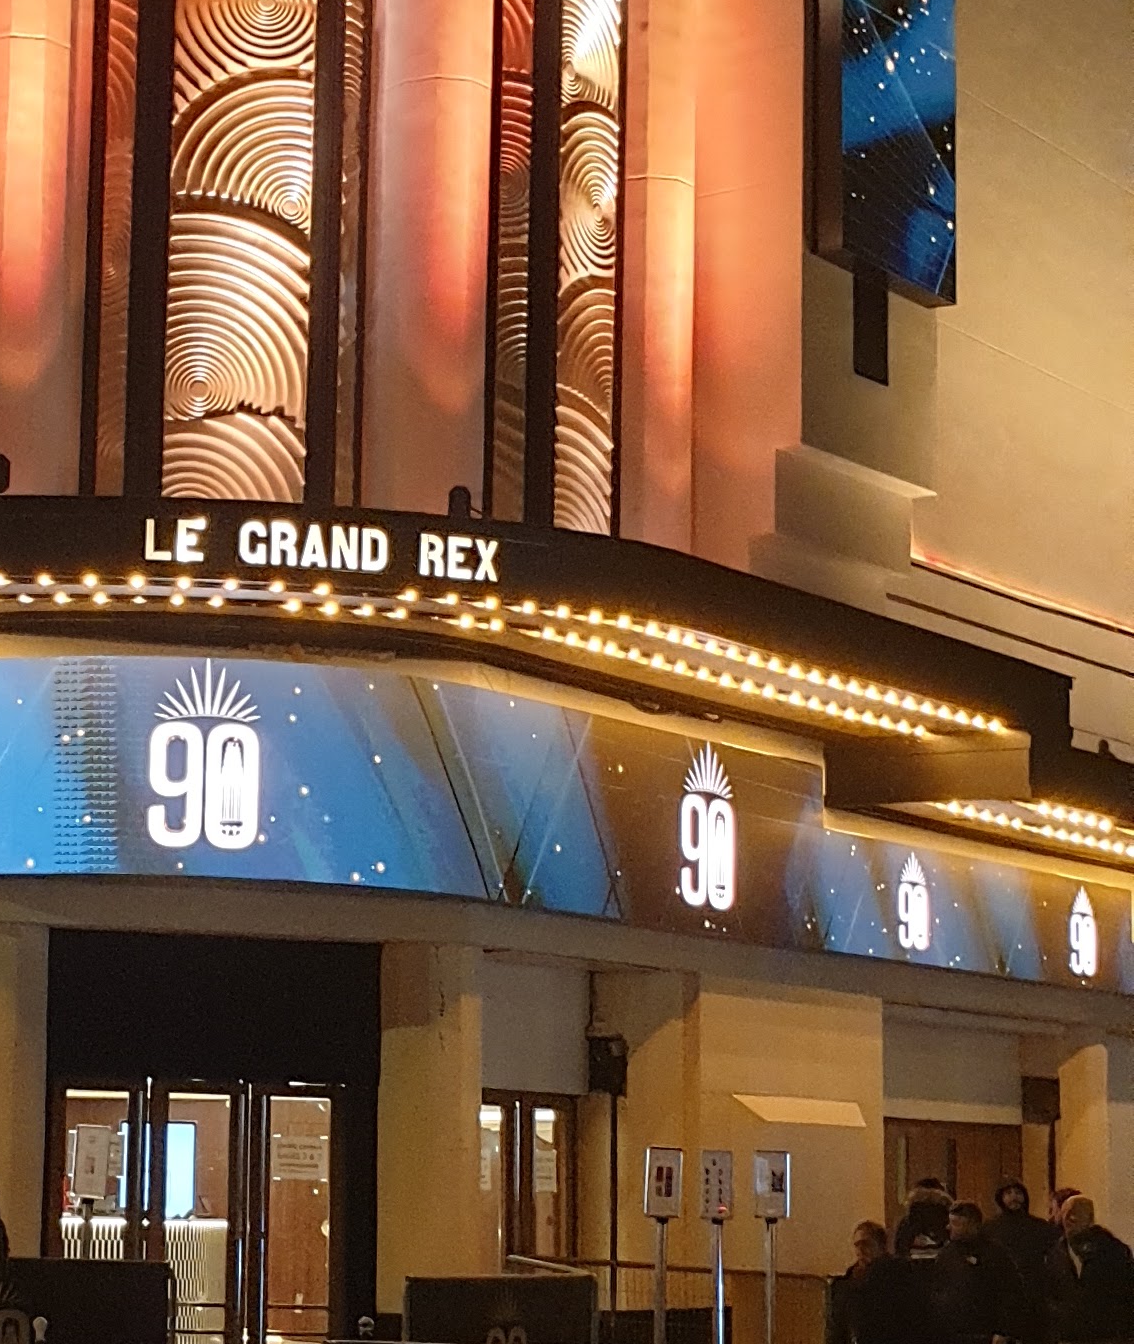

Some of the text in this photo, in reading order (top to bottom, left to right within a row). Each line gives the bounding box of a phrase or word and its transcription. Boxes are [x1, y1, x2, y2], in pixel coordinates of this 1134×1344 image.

[144, 517, 500, 583] LE GRAND REX
[147, 721, 260, 850] 90
[679, 792, 737, 911] 90
[898, 882, 930, 951] 90
[1069, 912, 1098, 978] 90
